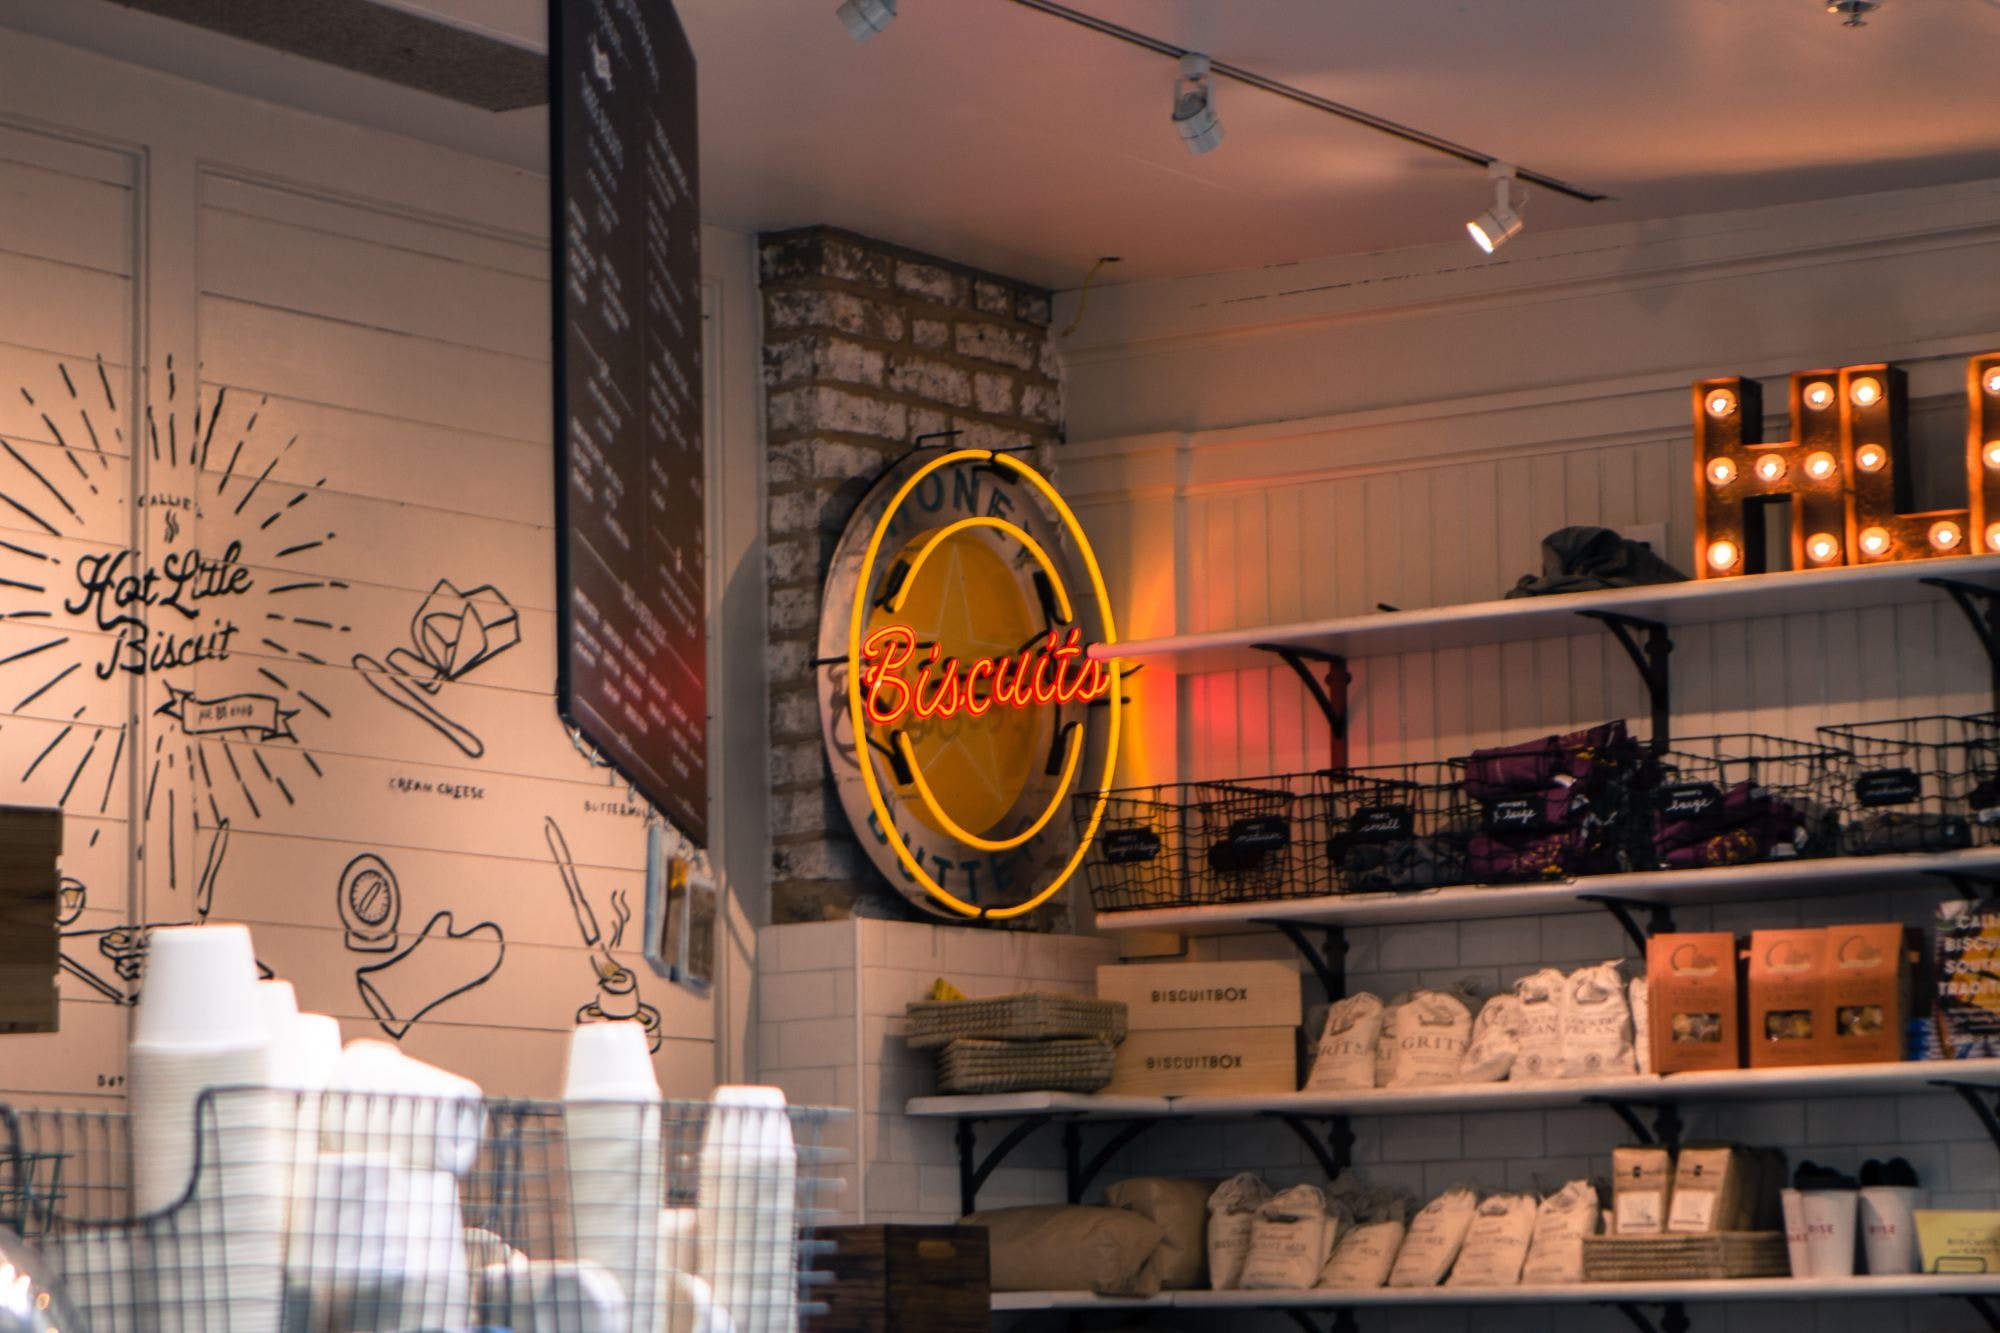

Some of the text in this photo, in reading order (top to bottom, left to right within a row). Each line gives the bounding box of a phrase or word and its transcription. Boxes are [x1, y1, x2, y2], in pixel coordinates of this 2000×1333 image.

[64, 540, 254, 630] Hot Little
[97, 618, 239, 680] Biscuit
[862, 624, 1112, 725] Biscuits
[437, 783, 484, 799] CHEESE
[1151, 986, 1248, 1003] BISCUITBOX
[1145, 1054, 1242, 1070] BISCUITBOX
